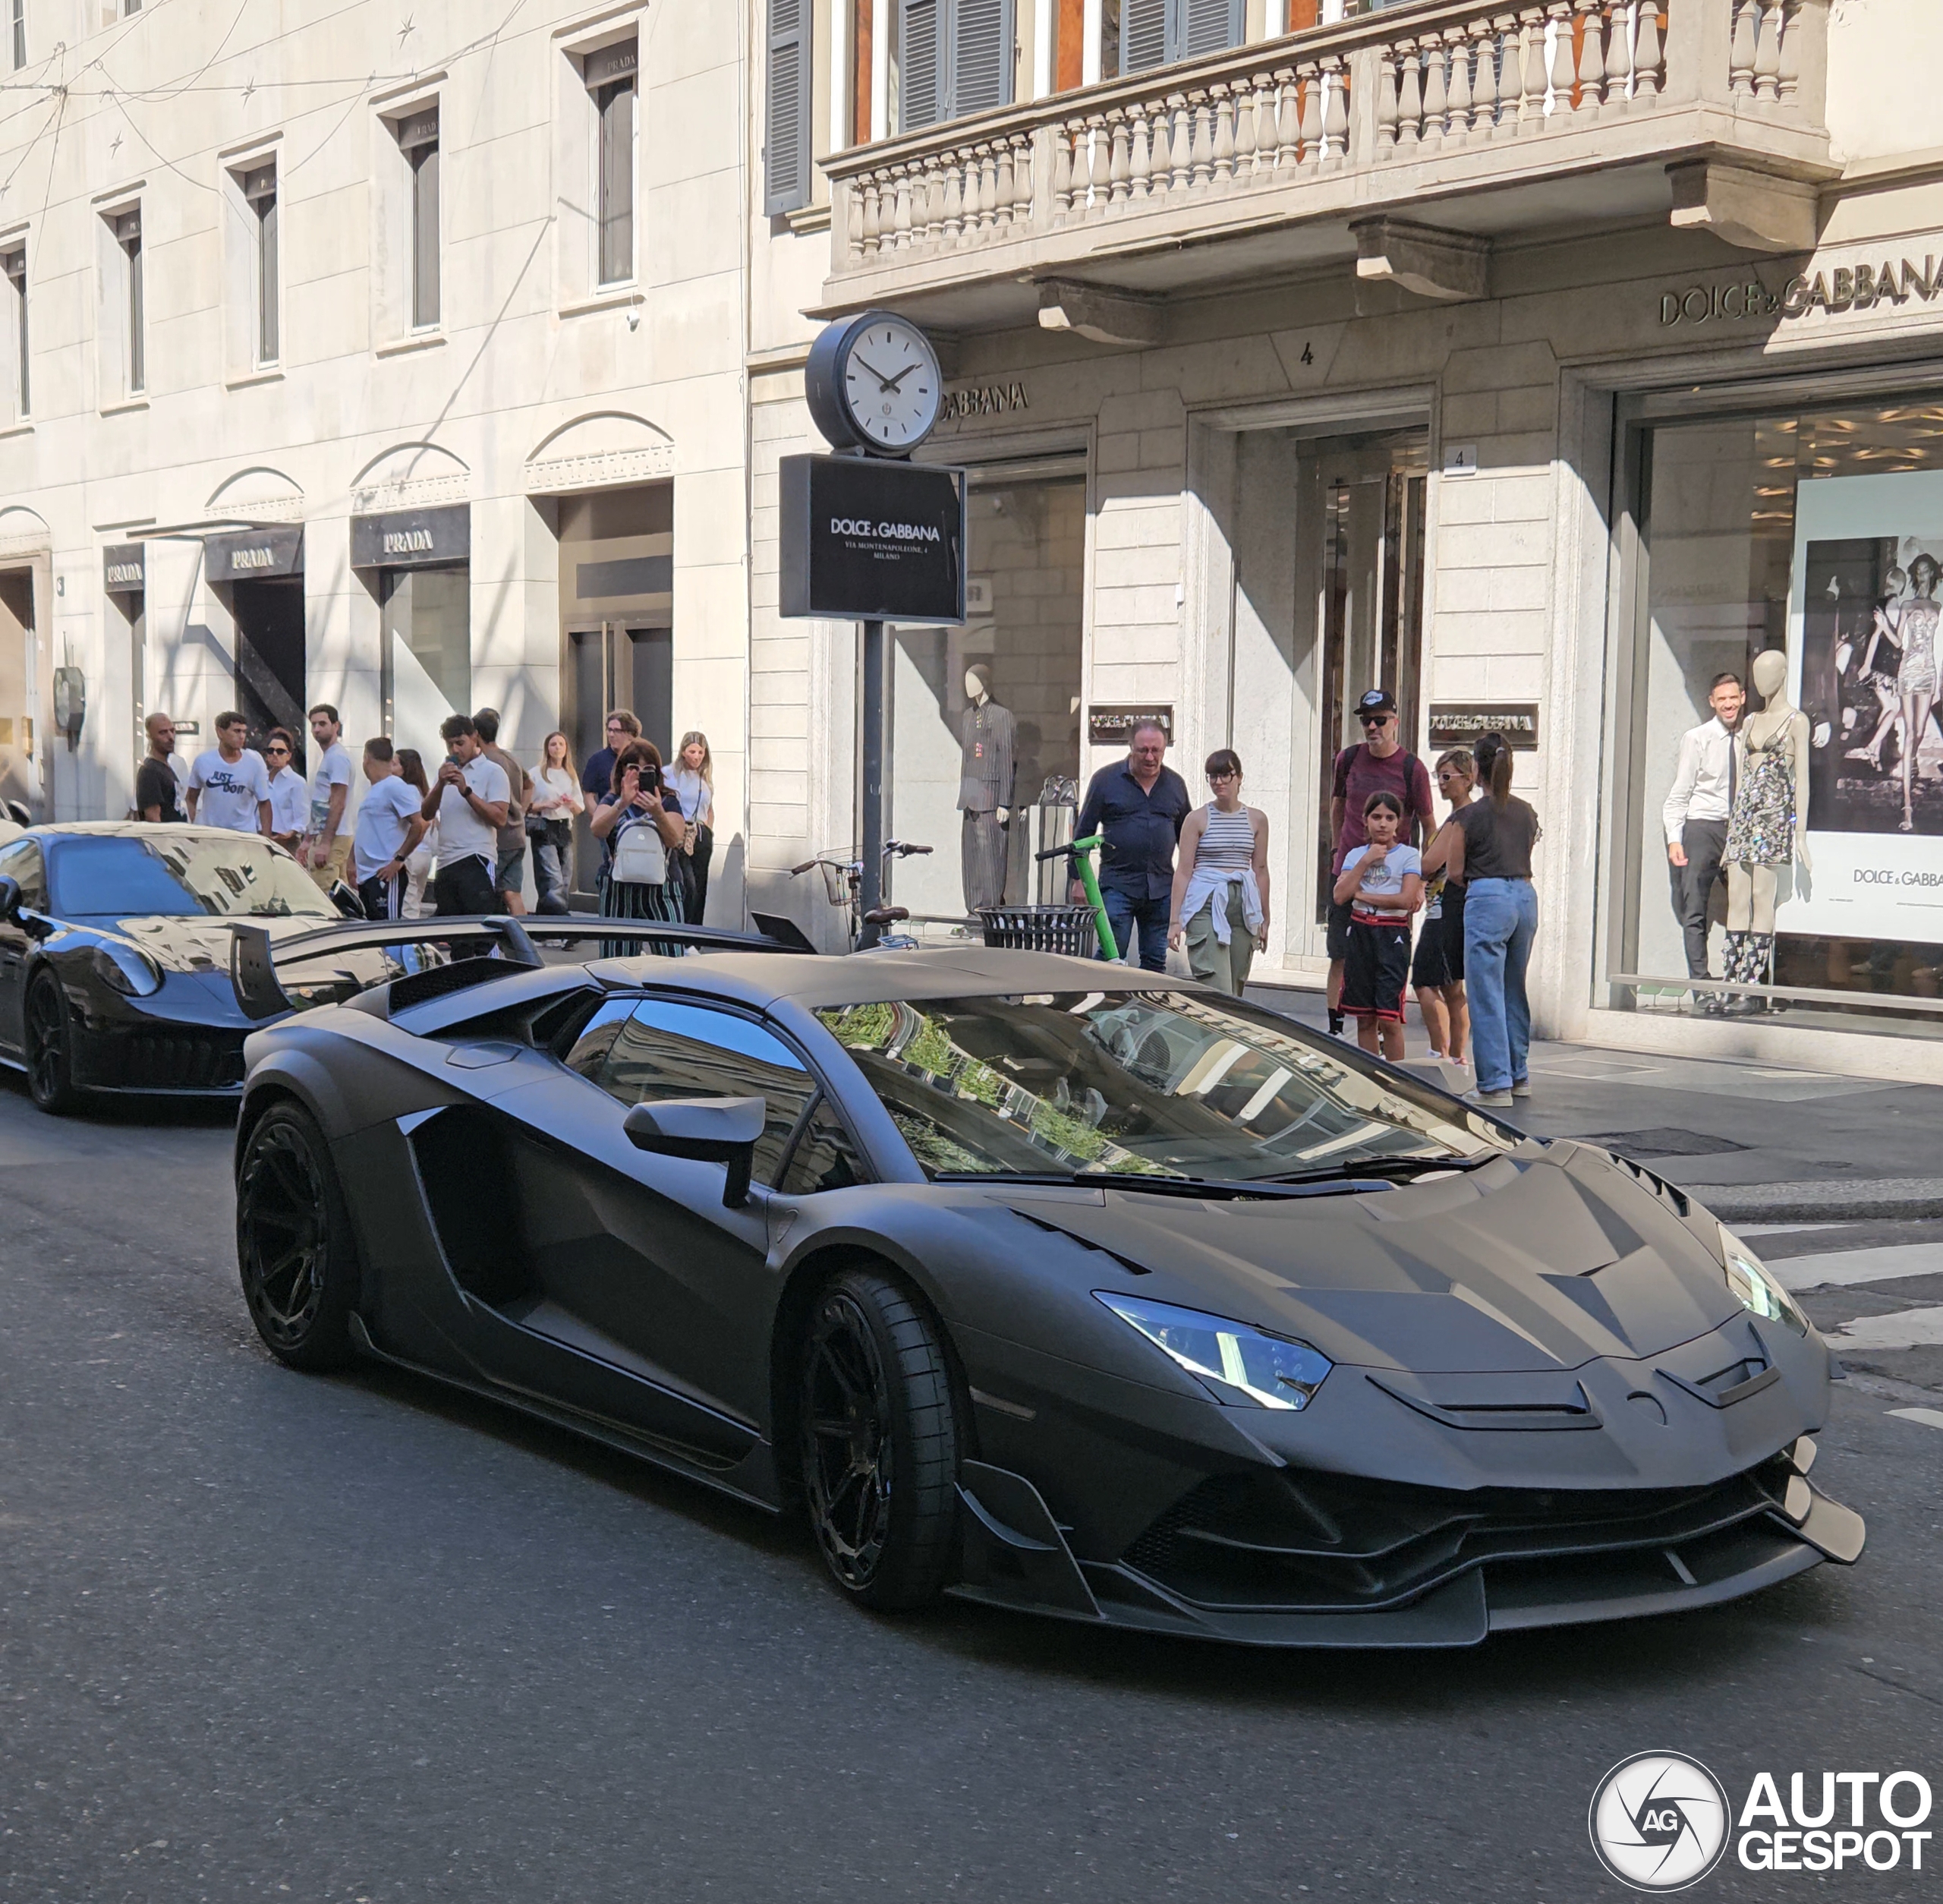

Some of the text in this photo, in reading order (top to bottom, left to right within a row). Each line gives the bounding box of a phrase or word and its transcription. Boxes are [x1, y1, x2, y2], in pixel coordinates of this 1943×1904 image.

[607, 55, 636, 72] PRADA
[1660, 280, 1762, 327] DOLCE
[1300, 341, 1314, 365] 4
[1455, 450, 1463, 467] 4
[830, 518, 871, 536] DOLCE
[878, 522, 940, 541] GABBANA
[383, 528, 433, 554] PRADA
[231, 547, 274, 569] PRADA
[874, 552, 900, 560] MILANO
[108, 562, 142, 583] PRADA
[210, 771, 234, 783] JUST
[1853, 868, 1894, 884] DOLCE
